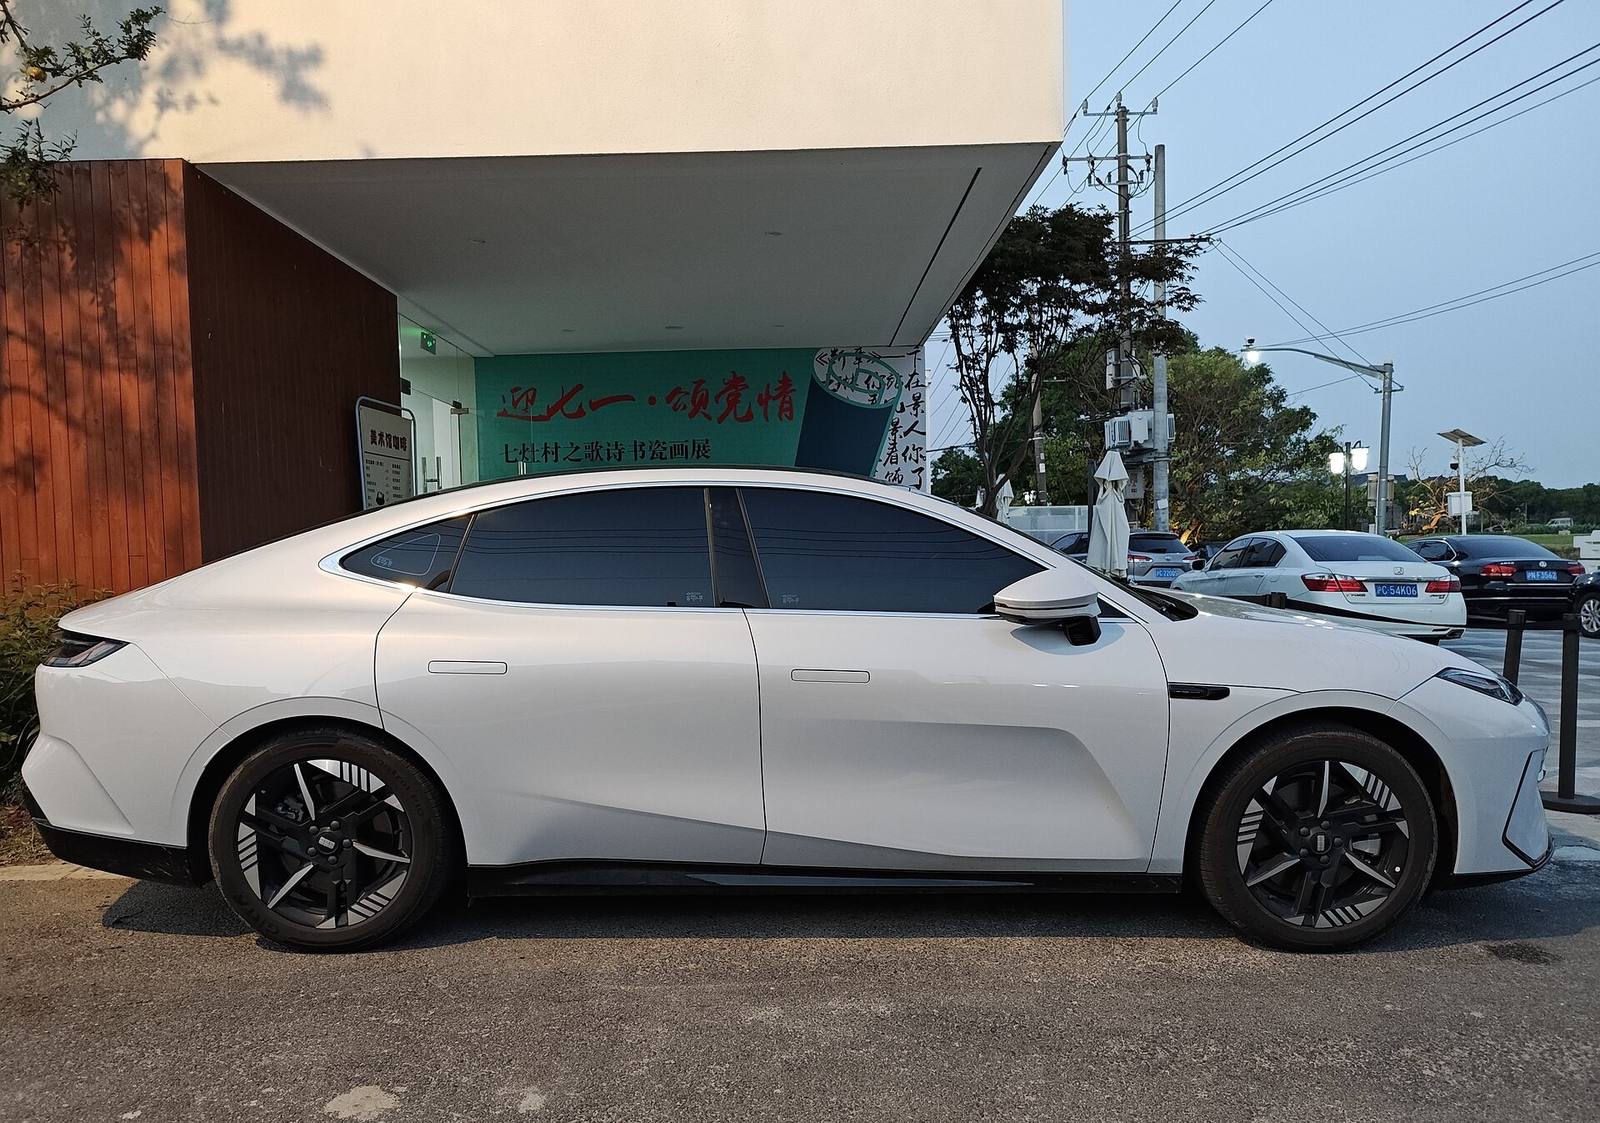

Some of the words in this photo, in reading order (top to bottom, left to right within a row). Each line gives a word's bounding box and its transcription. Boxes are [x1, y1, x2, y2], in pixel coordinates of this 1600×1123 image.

[370, 429, 408, 451] 美术馆咖啡
[500, 439, 711, 463] 七灶村之歌诗书瓷画展
